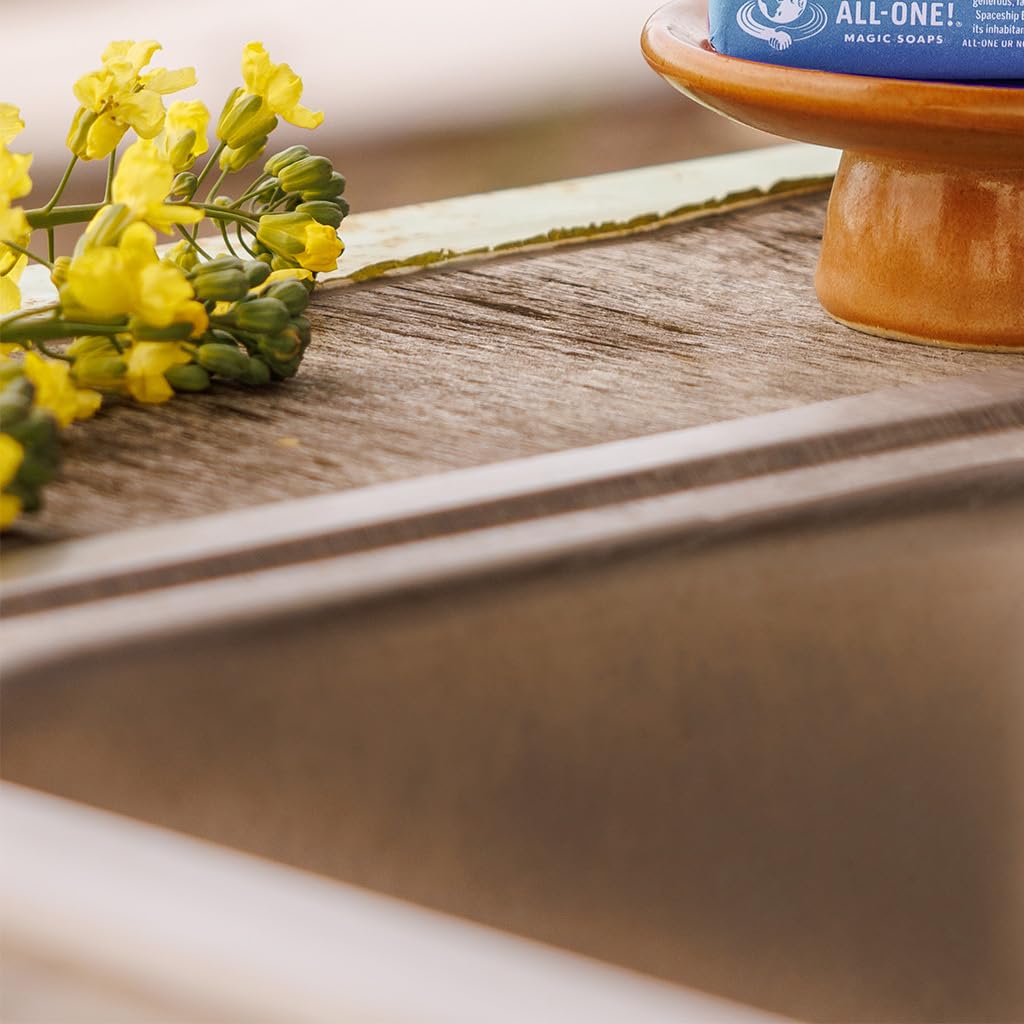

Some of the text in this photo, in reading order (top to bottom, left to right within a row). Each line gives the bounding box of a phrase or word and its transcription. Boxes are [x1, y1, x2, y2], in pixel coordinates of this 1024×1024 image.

[975, 10, 1020, 22] Spaceship
[972, 24, 984, 34] its
[844, 33, 944, 44] MAGIC SOAPS
[962, 39, 999, 48] ALL-ONE
[1001, 39, 1013, 48] OR
